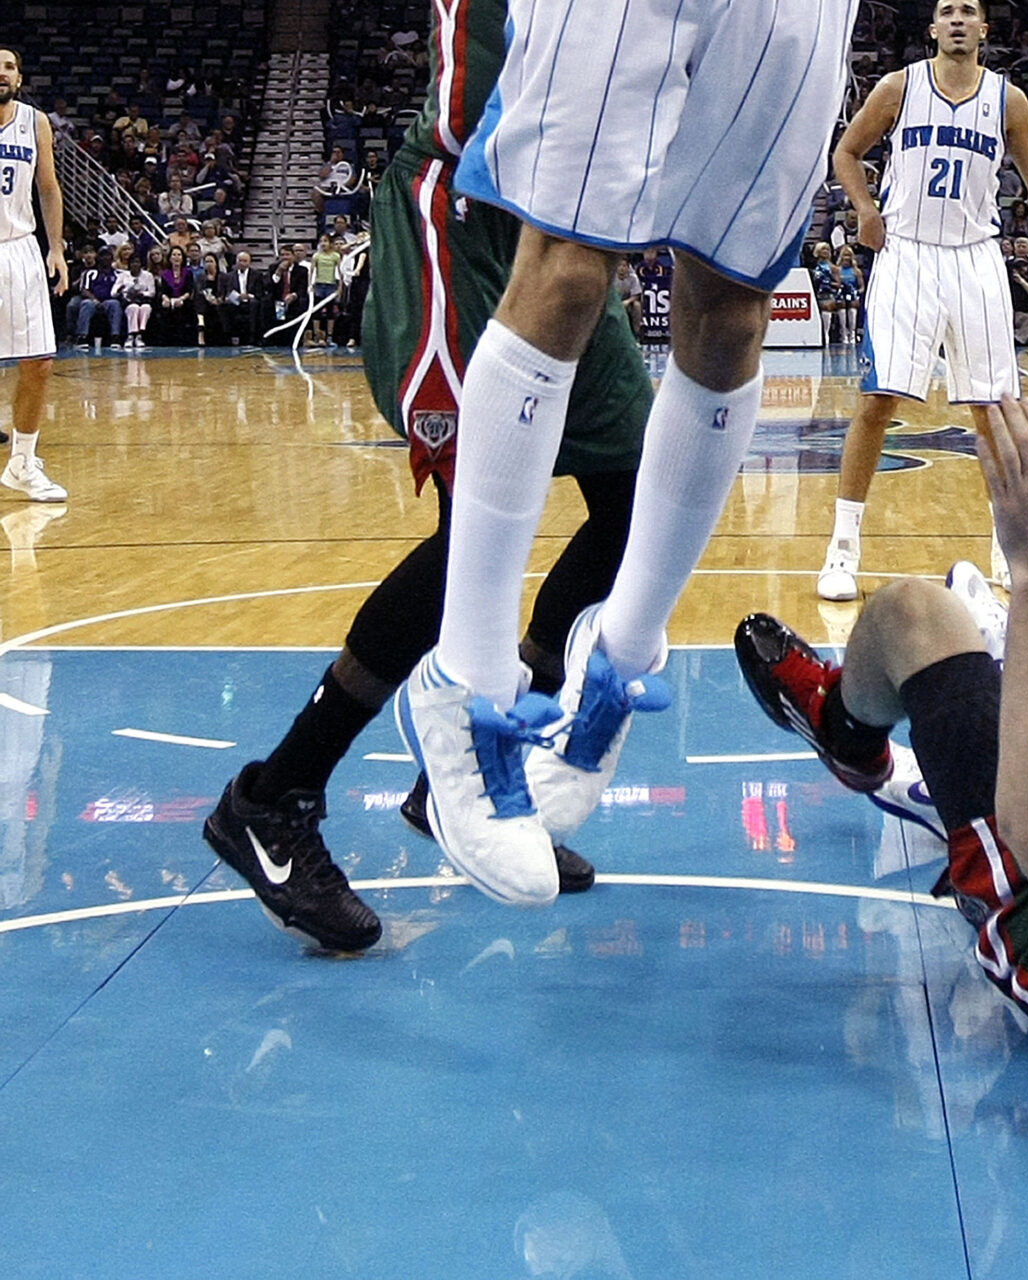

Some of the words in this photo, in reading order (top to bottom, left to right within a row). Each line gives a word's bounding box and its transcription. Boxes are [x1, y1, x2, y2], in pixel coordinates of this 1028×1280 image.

[902, 126, 933, 151] NEW
[937, 126, 998, 161] ORLEANS
[928, 158, 963, 199] 21
